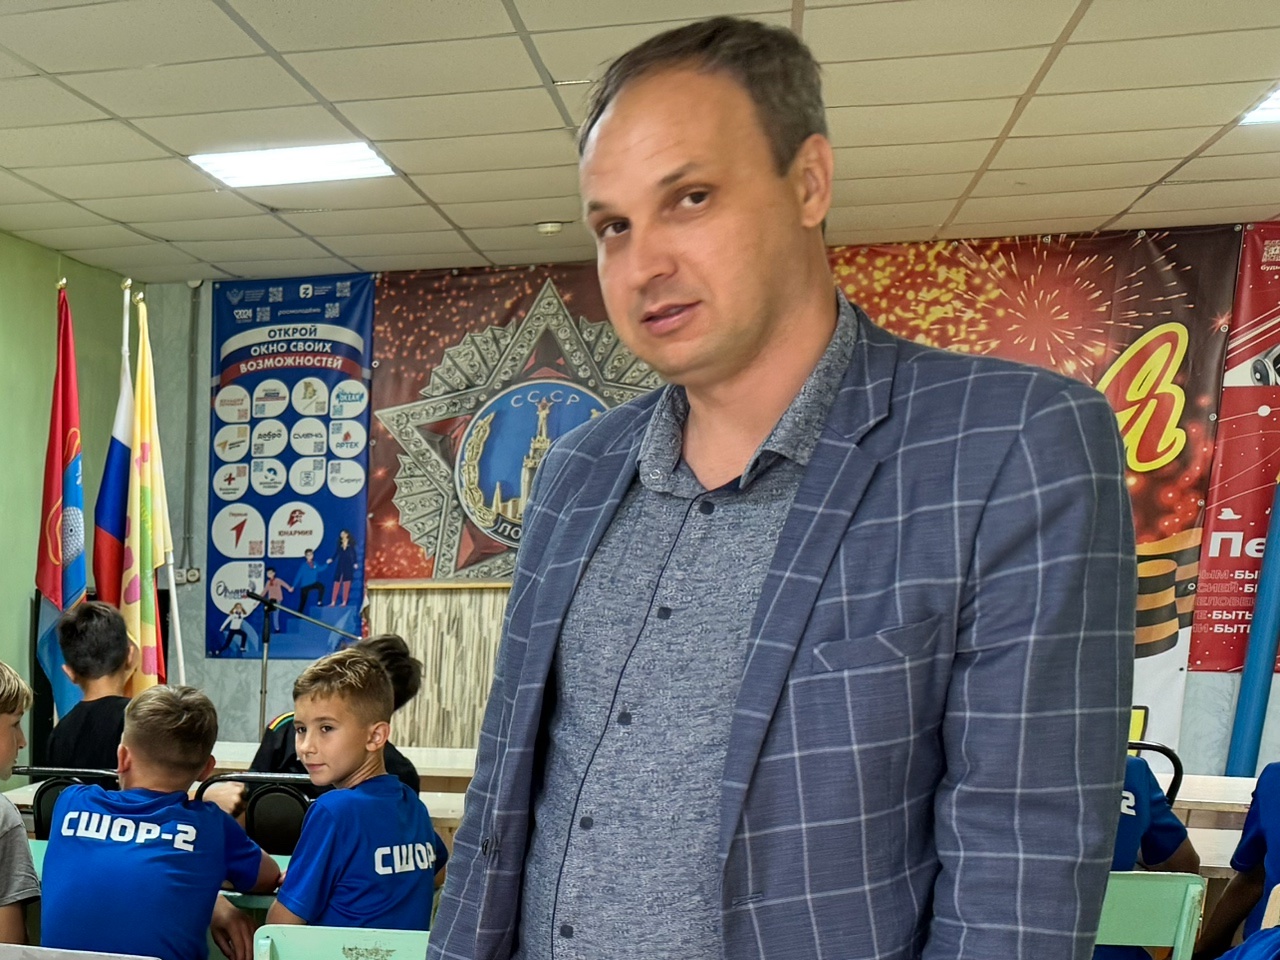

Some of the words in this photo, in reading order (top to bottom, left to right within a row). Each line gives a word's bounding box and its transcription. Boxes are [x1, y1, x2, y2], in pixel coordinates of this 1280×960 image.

[268, 325, 317, 339] ОТКРОЙ
[251, 343, 287, 356] ОКНО
[290, 342, 332, 353] СВОИХ
[240, 356, 342, 373] ВОЗМОЖНОСТЕЙ
[511, 390, 580, 408] СССР
[61, 811, 196, 852] СШОР-2
